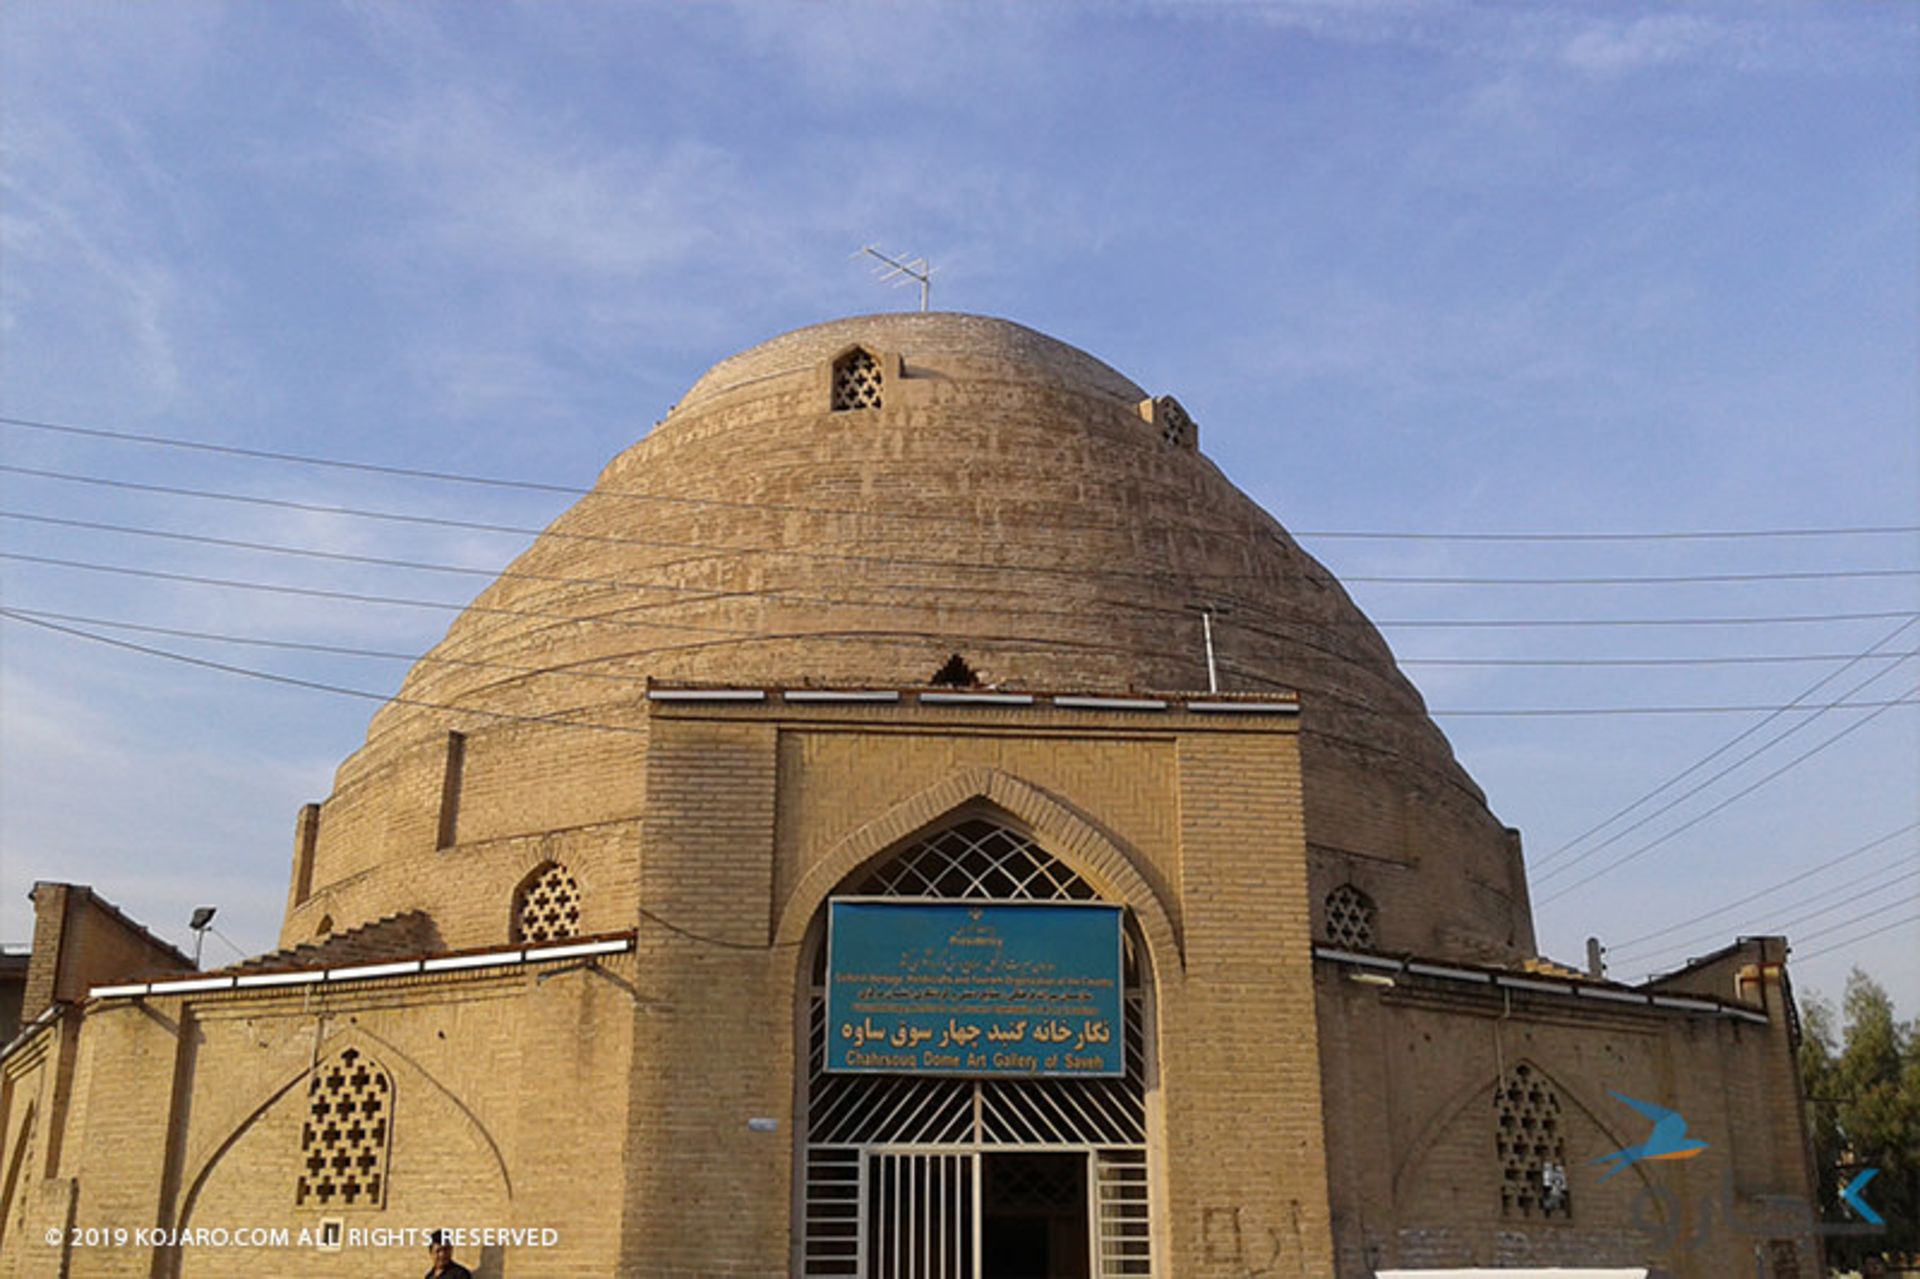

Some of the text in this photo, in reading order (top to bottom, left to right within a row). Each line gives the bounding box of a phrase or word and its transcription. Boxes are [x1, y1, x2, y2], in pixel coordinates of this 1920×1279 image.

[841, 1016, 886, 1047] ساوه
[890, 1019, 933, 1047] سوق
[923, 1050, 960, 1066] Dome
[967, 1051, 987, 1067] Art
[993, 1052, 1038, 1072] Gallery
[1044, 1053, 1058, 1068] of
[1064, 1053, 1103, 1069] Saveh
